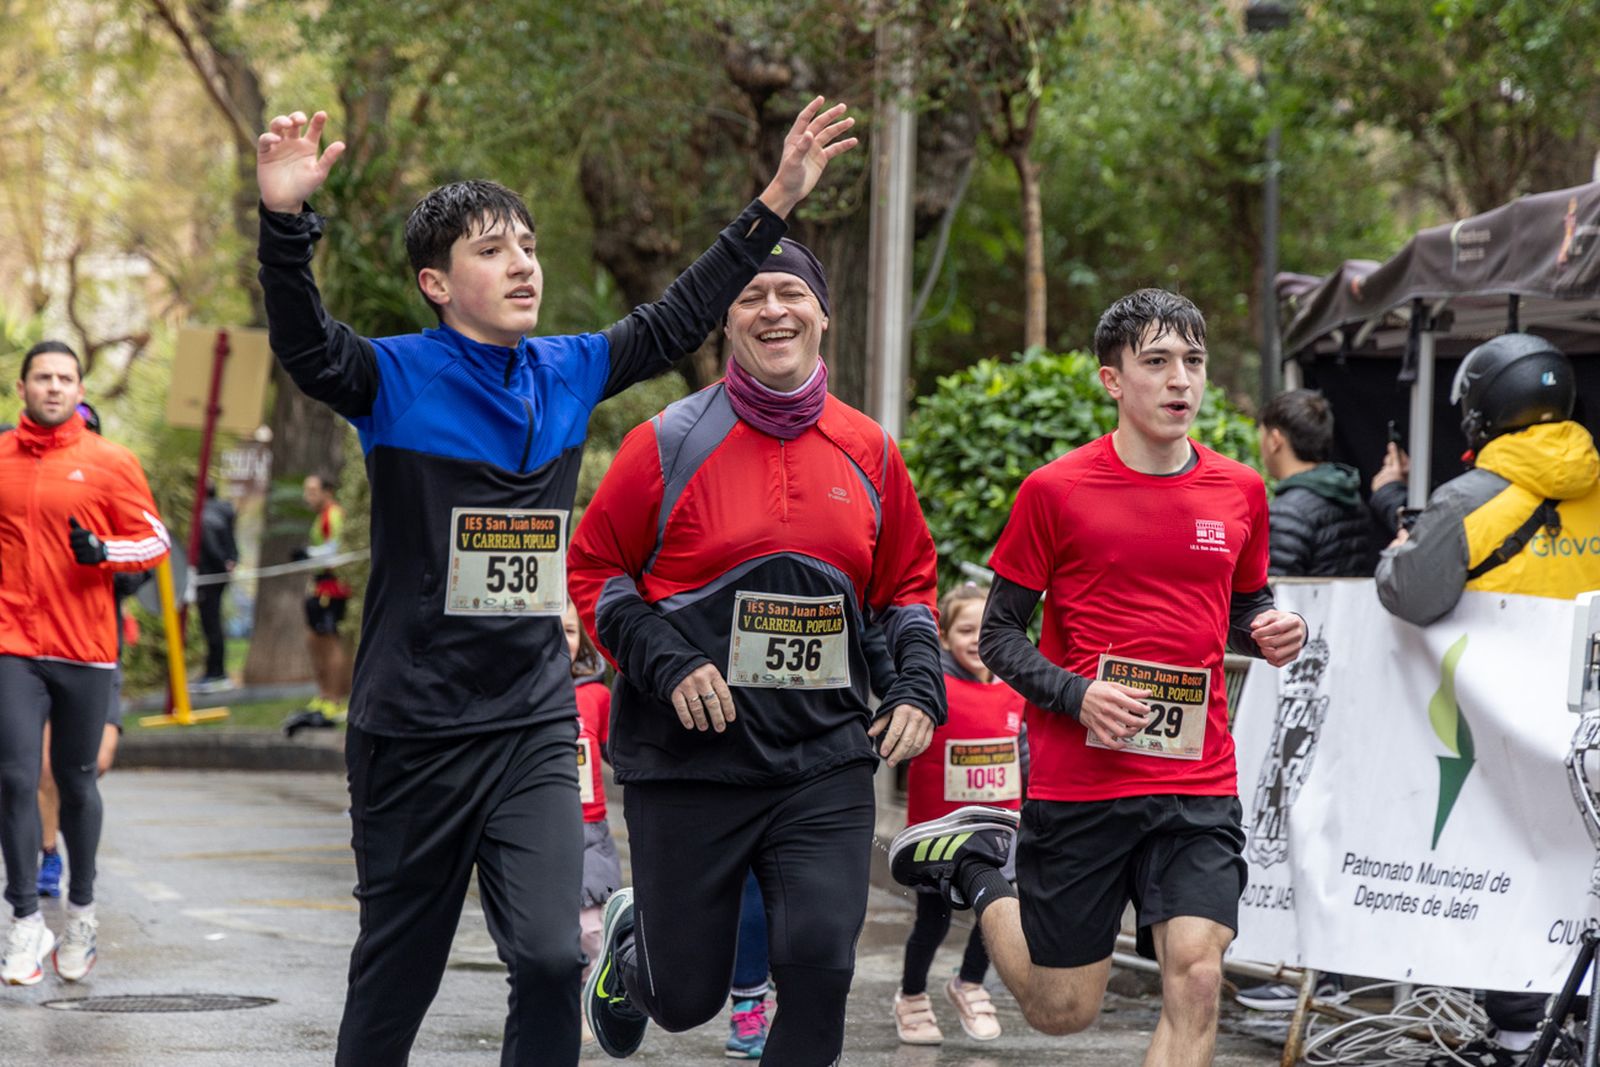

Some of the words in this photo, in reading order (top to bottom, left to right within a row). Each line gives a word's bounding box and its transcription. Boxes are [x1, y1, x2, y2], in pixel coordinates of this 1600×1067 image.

[465, 517, 483, 530] IES
[486, 517, 507, 530] San
[509, 518, 529, 530] Juan
[531, 518, 555, 530] Bosco
[461, 533, 470, 548] V
[472, 533, 521, 549] CARRERA
[523, 534, 556, 549] POPULAR
[486, 556, 538, 593] 538
[747, 601, 765, 613] IES
[768, 603, 788, 616] San
[791, 605, 816, 617] Juan
[818, 605, 842, 617] Bosco
[743, 615, 752, 629] V
[754, 616, 803, 633] CARRERA
[806, 618, 843, 634] POPULAR
[765, 637, 822, 672] 536
[1111, 663, 1128, 677] IES
[1131, 666, 1152, 680] San
[1154, 670, 1179, 685] Juan
[1181, 674, 1203, 686] Bosco
[1168, 686, 1203, 703] POPULAR
[1126, 701, 1184, 739] 29
[967, 767, 1006, 789] 1043
[1341, 852, 1413, 882] Patronato
[1416, 862, 1490, 894] Municipal
[1490, 871, 1511, 894] de
[1353, 885, 1419, 915] Deportes
[1421, 894, 1442, 917] de
[1444, 897, 1479, 920] Jaén
